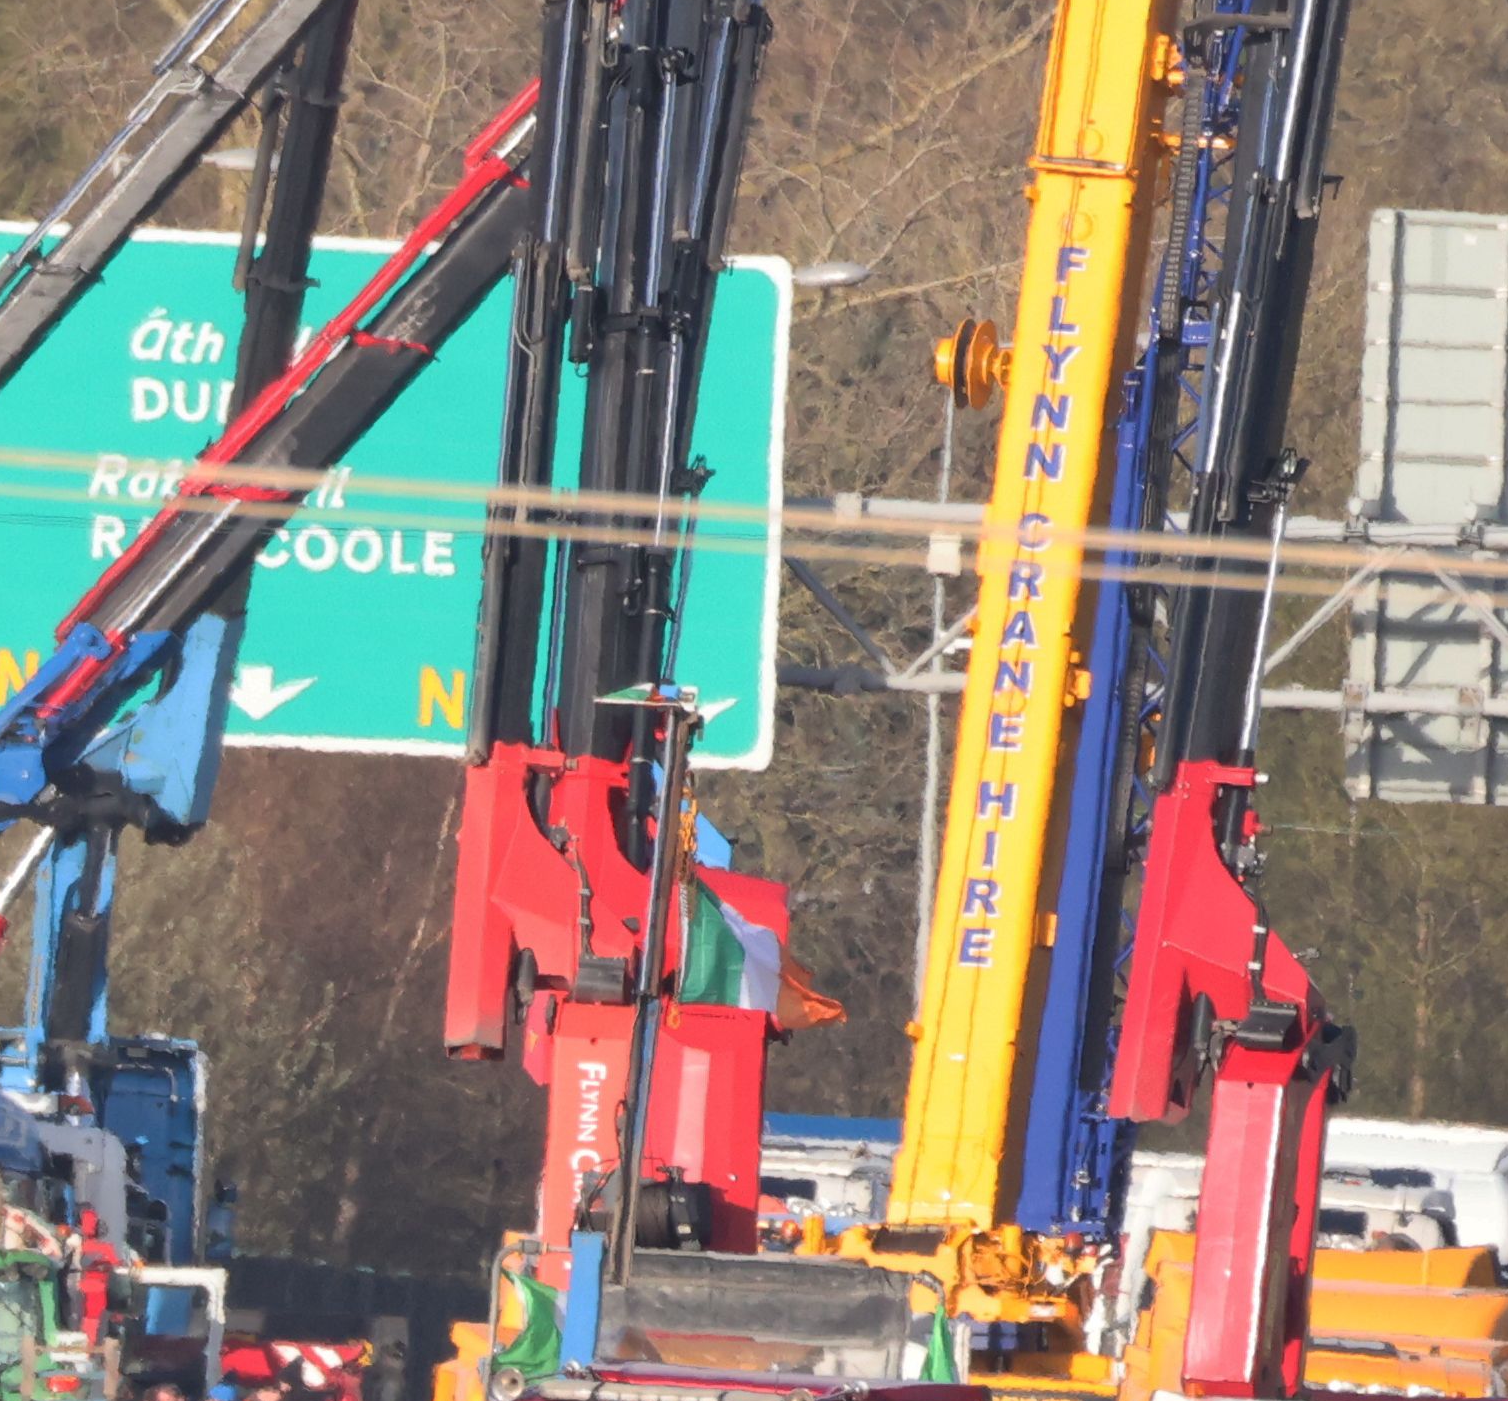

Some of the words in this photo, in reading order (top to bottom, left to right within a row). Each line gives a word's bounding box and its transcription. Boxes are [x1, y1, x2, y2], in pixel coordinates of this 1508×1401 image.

[1021, 246, 1090, 483] FLYNN
[989, 512, 1053, 753] CRANE
[958, 780, 1020, 969] HIRE
[577, 1062, 608, 1143] FLYNN
